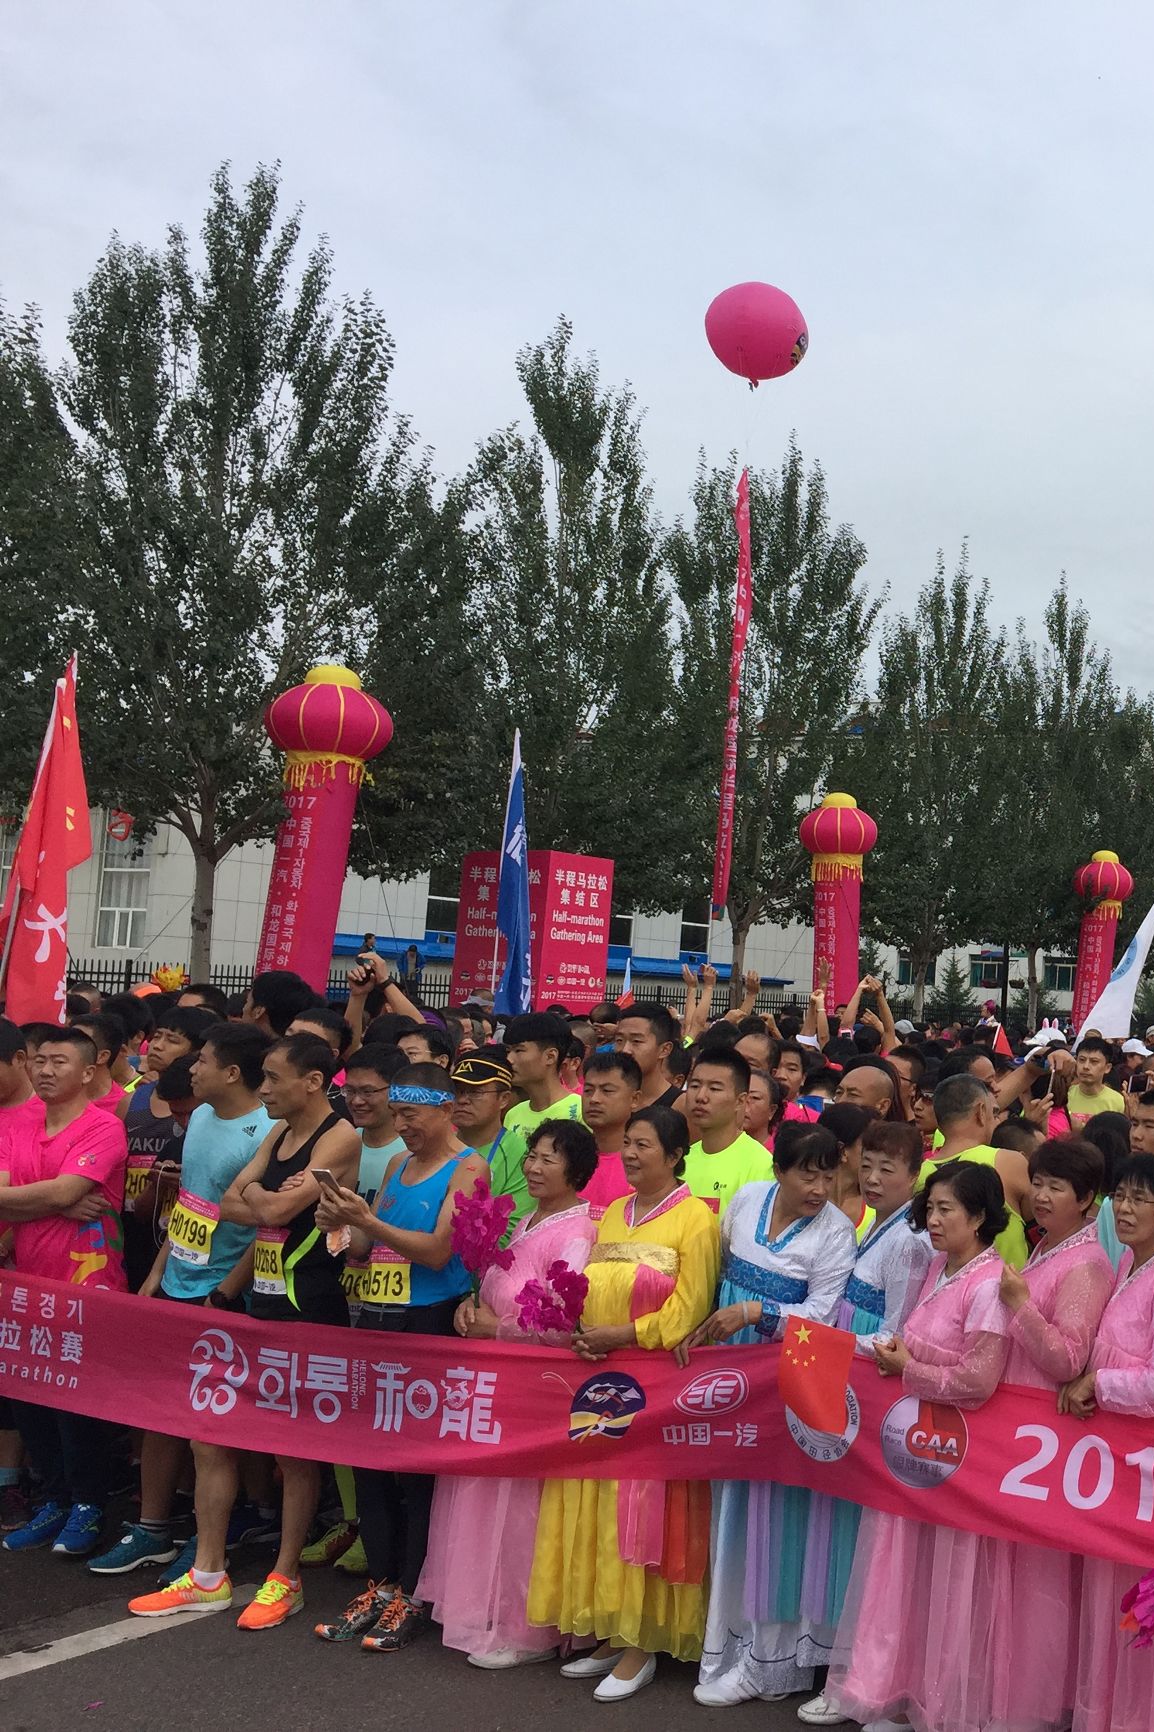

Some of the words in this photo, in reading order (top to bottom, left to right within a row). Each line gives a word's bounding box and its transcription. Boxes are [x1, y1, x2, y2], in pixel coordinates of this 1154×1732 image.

[555, 869, 608, 891] 半程马拉松
[560, 888, 600, 908] 集结区
[552, 909, 604, 927] Half-marathon
[550, 927, 586, 944] Gathering
[587, 930, 604, 944] Area
[541, 991, 557, 1000] 2017
[169, 1209, 207, 1247] H0199
[254, 1247, 278, 1275] 0268
[351, 1358, 360, 1411] MARATHON
[359, 1359, 367, 1396] HELONG
[661, 1421, 759, 1448] 中国一汽
[885, 1424, 905, 1437] Road
[911, 1430, 959, 1457] CAA
